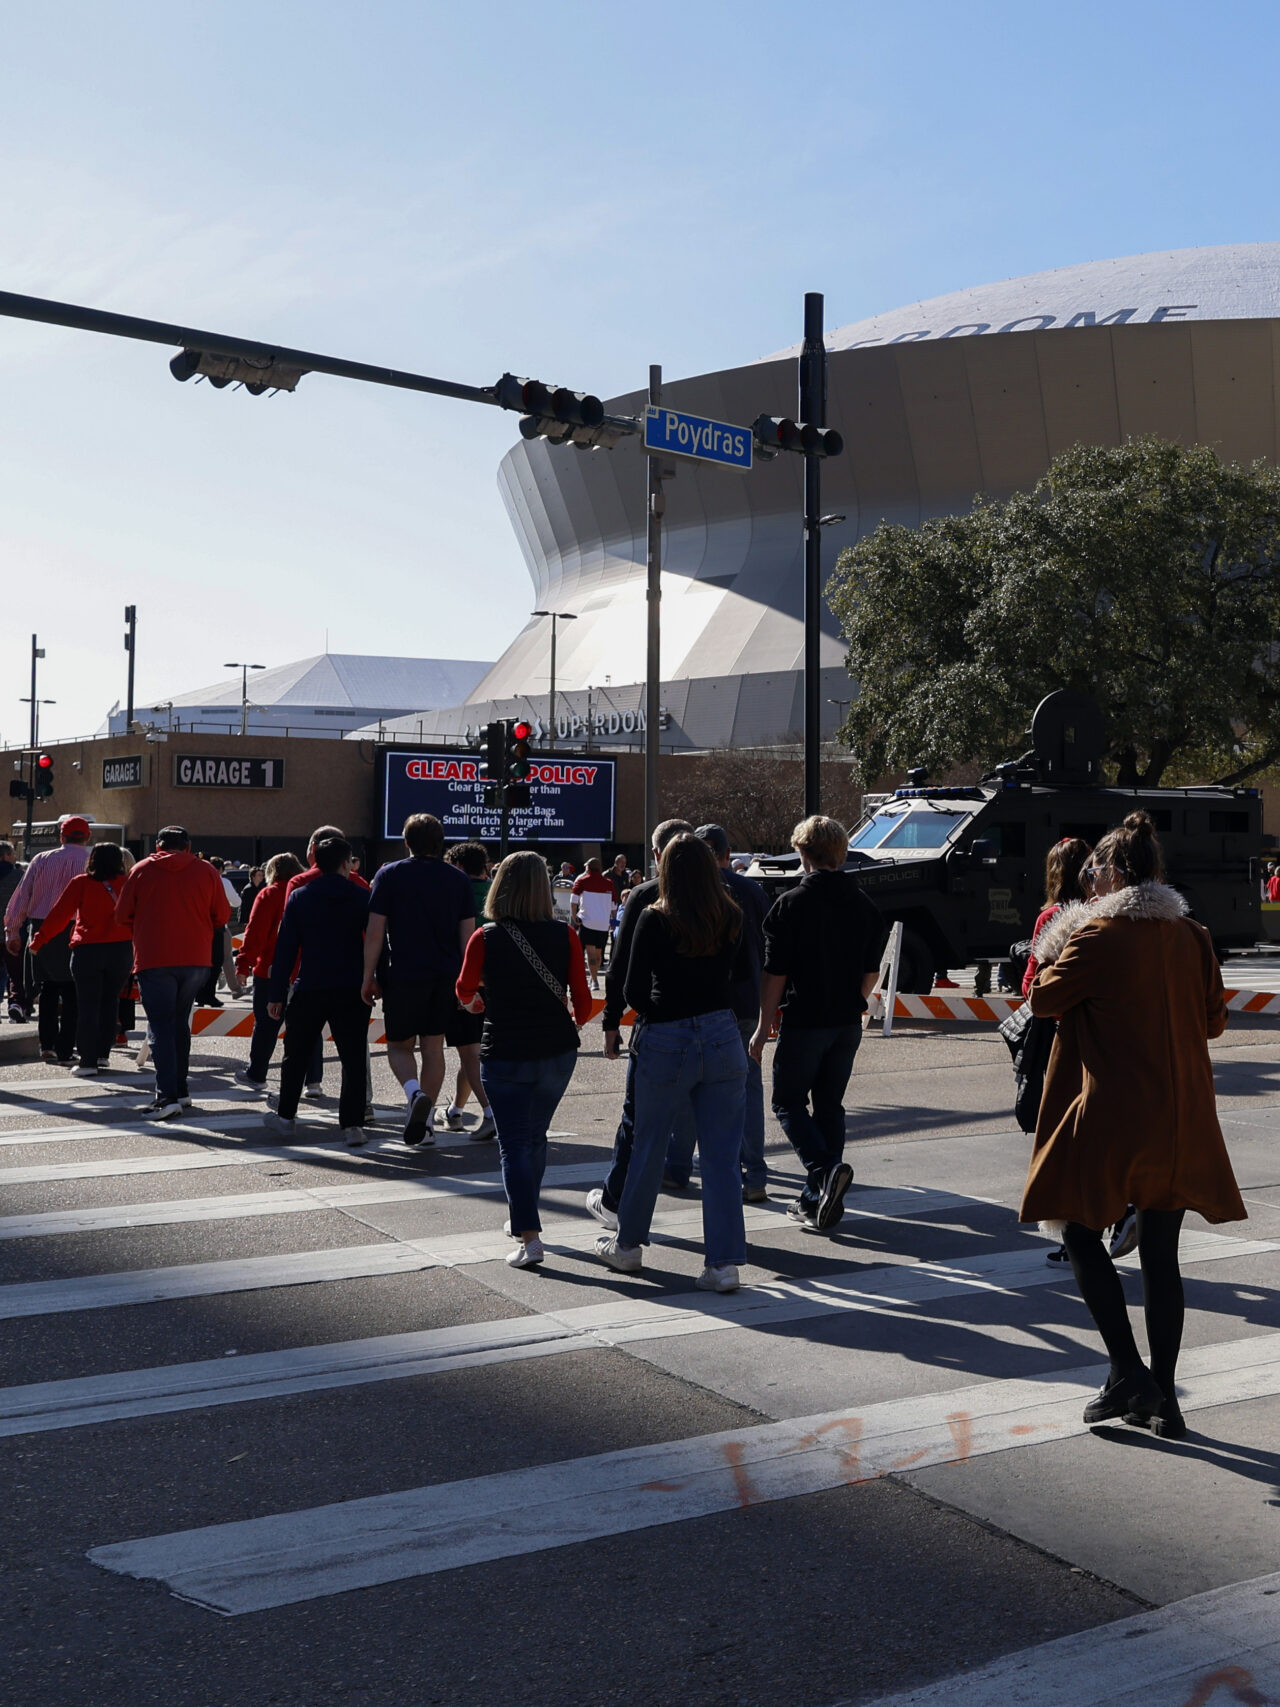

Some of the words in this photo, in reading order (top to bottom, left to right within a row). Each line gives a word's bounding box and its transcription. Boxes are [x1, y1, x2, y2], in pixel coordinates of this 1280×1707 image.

[665, 412, 744, 457] Poydras
[104, 764, 135, 784] GARAGE
[135, 763, 140, 781] 1
[180, 759, 251, 785] GARAGE
[261, 760, 274, 787] 1
[406, 759, 477, 781] CLEAR
[524, 764, 598, 786] POLICY
[448, 782, 472, 792] Clear
[540, 785, 561, 795] than
[452, 804, 483, 815] Gallon
[534, 806, 556, 817] Bags
[442, 815, 469, 825] Small
[470, 815, 500, 826] Clutch
[515, 816, 543, 829] larger
[544, 817, 564, 827] than
[879, 870, 920, 884] POLICE
